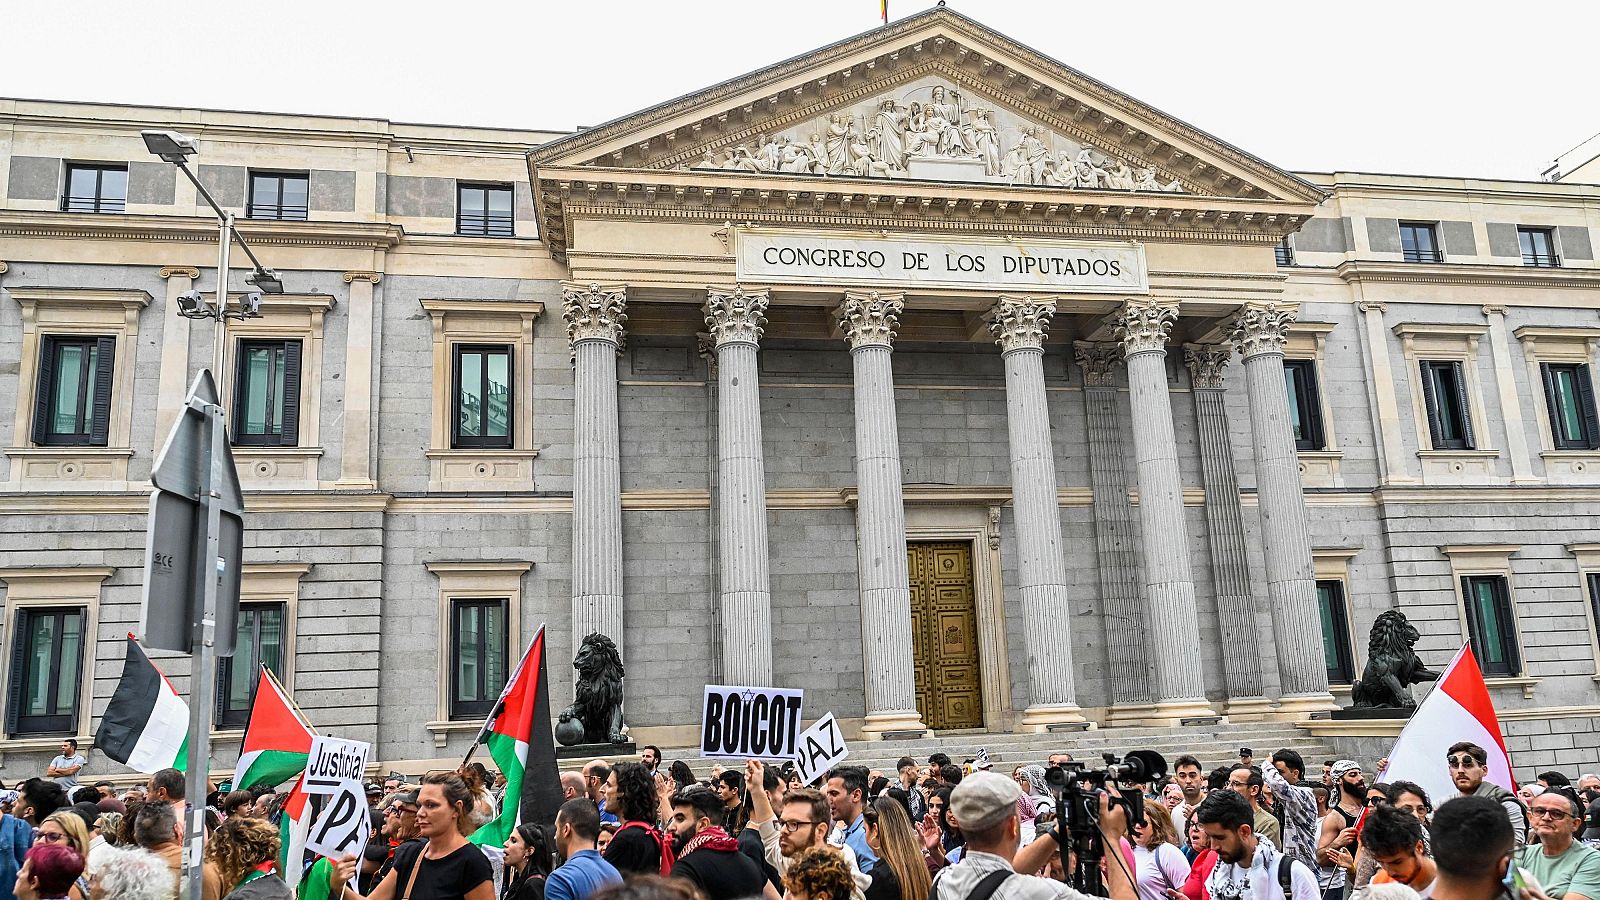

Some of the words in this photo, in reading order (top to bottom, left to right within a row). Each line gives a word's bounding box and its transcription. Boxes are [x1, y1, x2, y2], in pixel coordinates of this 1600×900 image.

[763, 247, 886, 268] CONGRESO
[902, 252, 930, 271] DE
[945, 254, 986, 272] LOS
[1002, 255, 1122, 276] DIPUTADOS
[704, 692, 802, 755] BOICOT
[797, 718, 844, 781] PAZ
